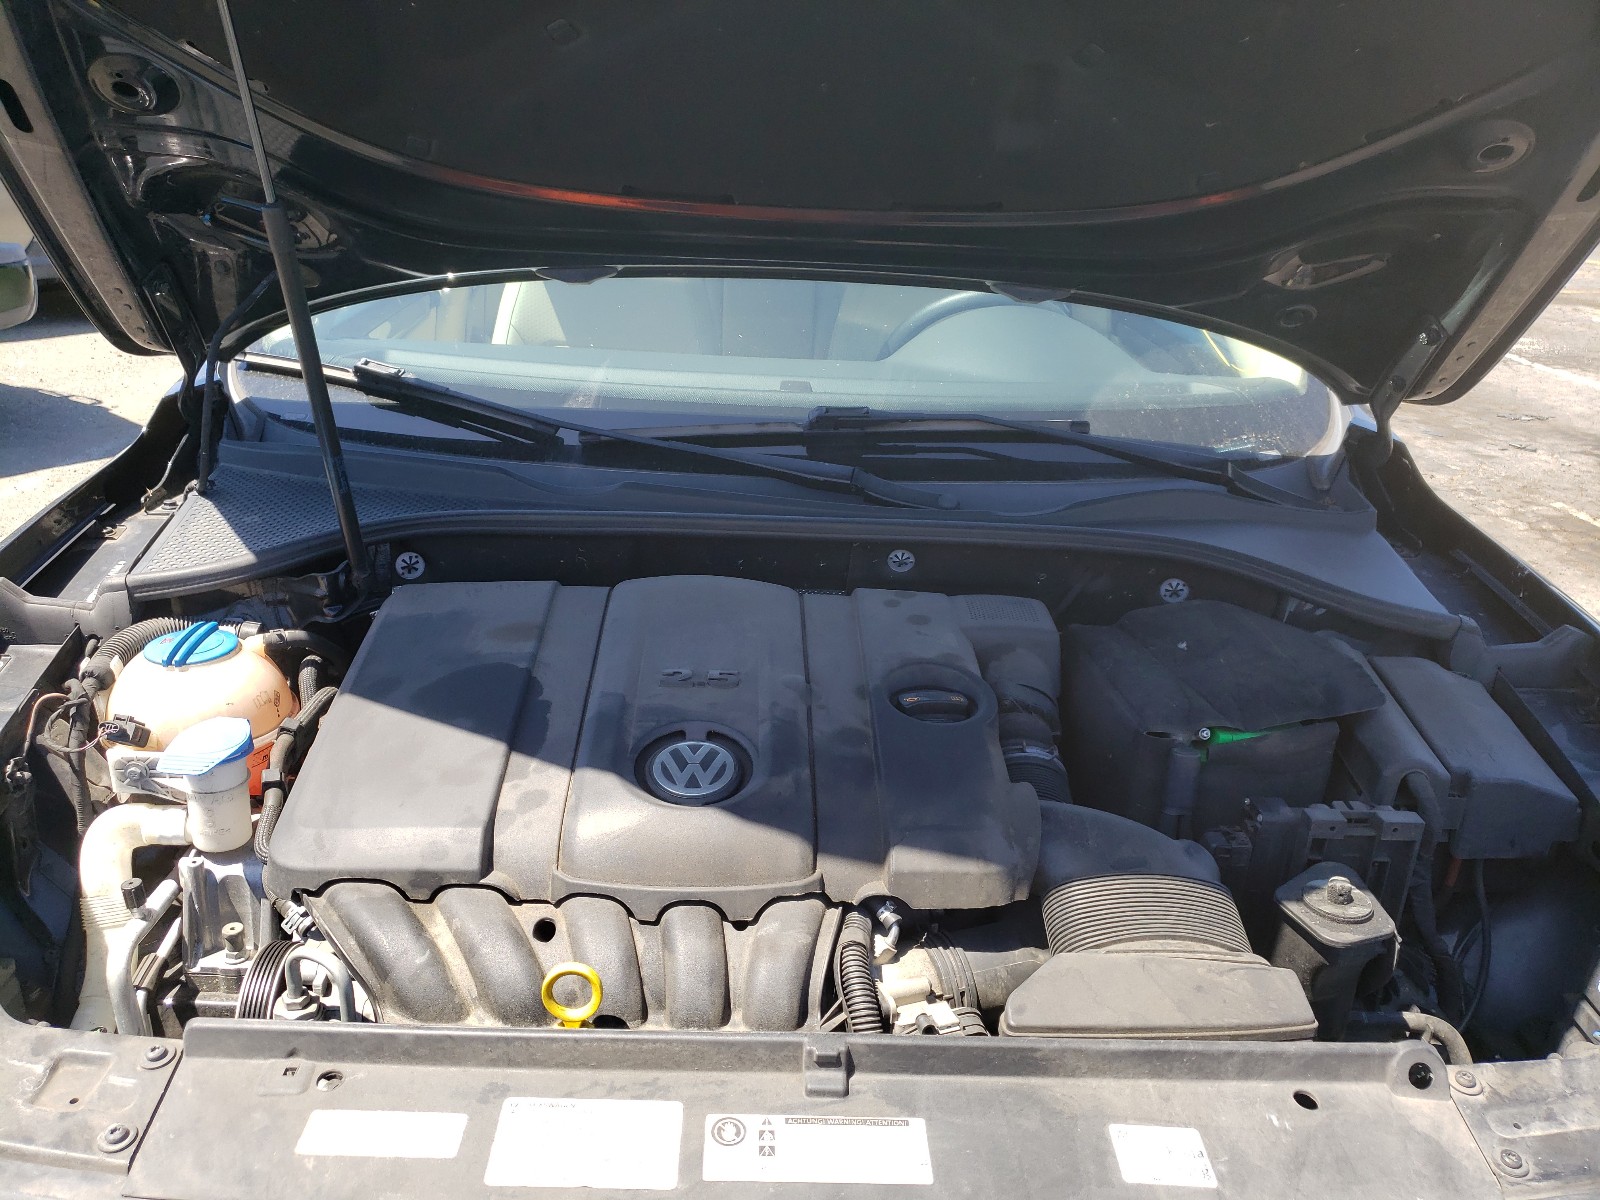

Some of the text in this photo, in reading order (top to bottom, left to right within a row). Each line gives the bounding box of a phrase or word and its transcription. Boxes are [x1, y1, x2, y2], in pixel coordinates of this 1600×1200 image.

[659, 668, 741, 689] 2.5
[787, 1117, 908, 1127] ACHTUNG! WARNING! ATTENTION!
